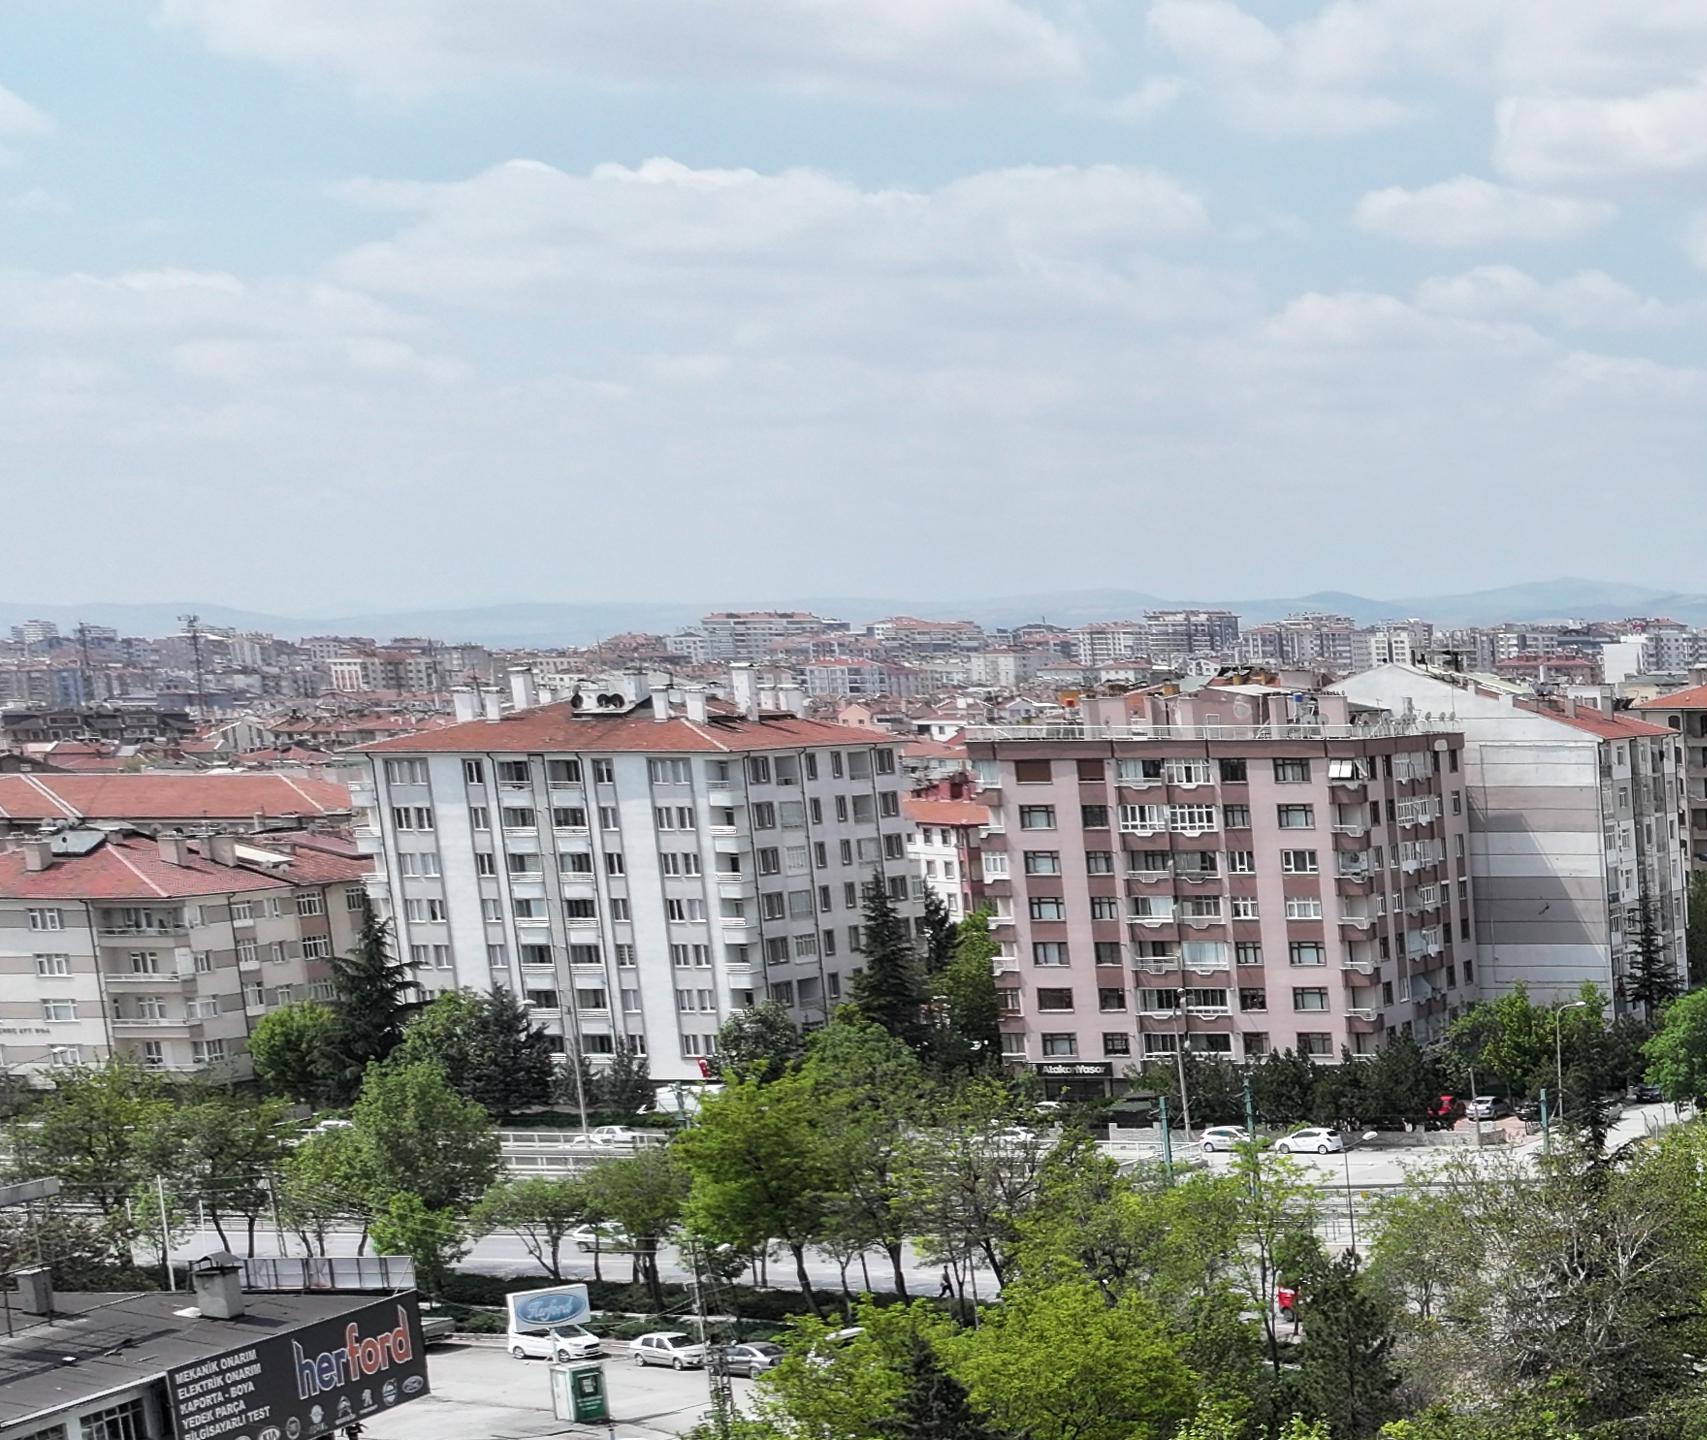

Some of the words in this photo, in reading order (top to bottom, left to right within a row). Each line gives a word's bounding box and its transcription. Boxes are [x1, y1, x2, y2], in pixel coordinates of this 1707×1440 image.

[175, 1360, 220, 1385] MEKANİK
[220, 1349, 257, 1370] ONARIM
[291, 1304, 413, 1400] herford
[177, 1374, 224, 1400] ELEKTRİK
[225, 1363, 262, 1384] ONARIM
[179, 1391, 225, 1416] KAPORTA
[230, 1381, 255, 1398] BOYA
[182, 1409, 214, 1430] YEDEK
[215, 1400, 246, 1419] PARÇA
[247, 1405, 271, 1422] TEST
